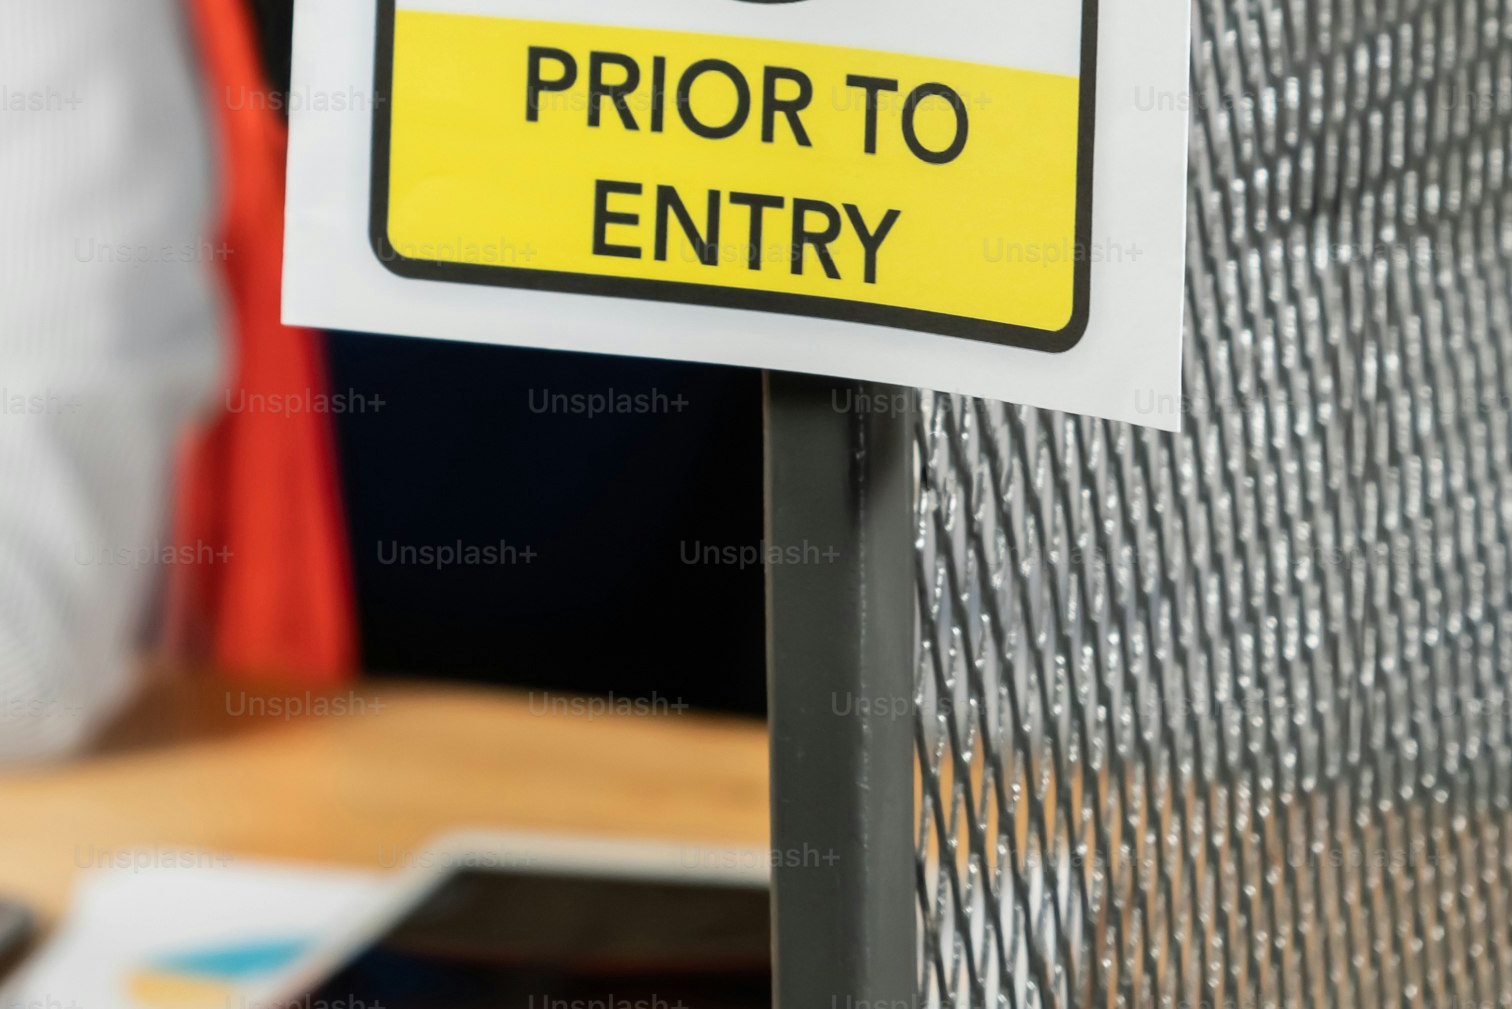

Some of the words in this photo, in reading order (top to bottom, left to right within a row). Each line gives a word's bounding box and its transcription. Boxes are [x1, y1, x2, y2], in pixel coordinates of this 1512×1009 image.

[526, 46, 813, 147] PRIOR
[845, 74, 969, 165] TO
[592, 179, 901, 285] ENTRY
